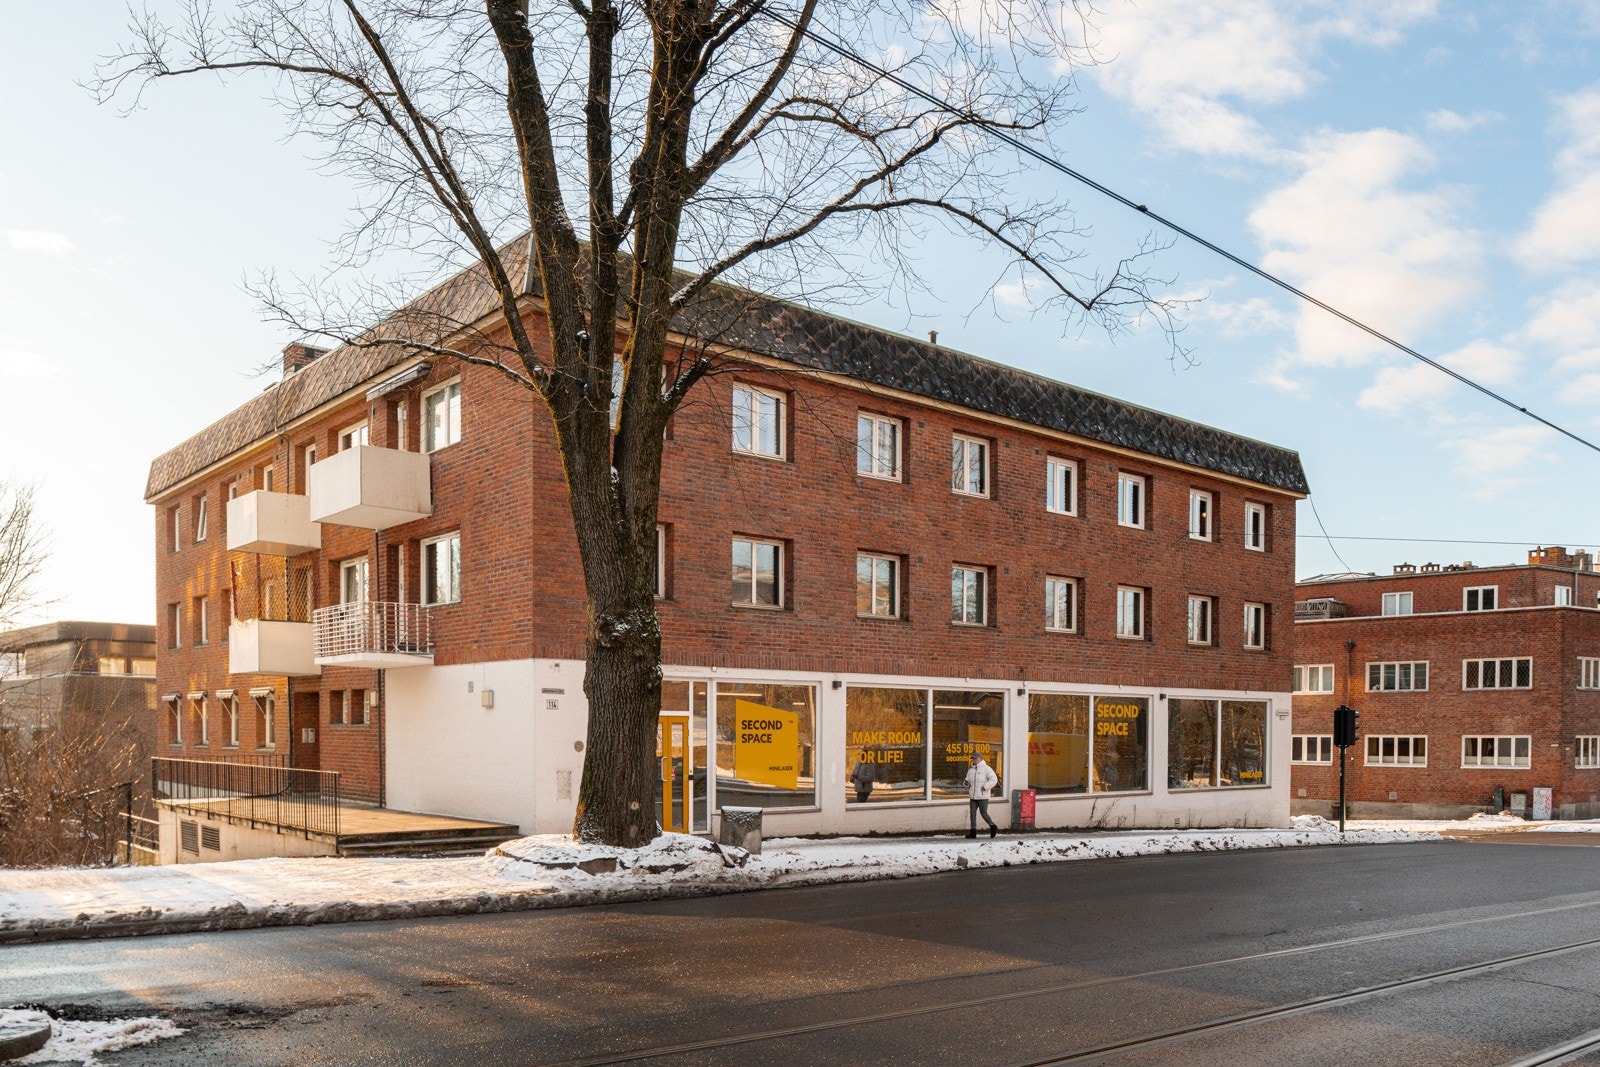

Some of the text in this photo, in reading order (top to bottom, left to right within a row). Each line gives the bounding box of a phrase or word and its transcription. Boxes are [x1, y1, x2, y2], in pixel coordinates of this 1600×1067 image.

[1097, 704, 1139, 718] SECOND
[741, 720, 783, 730] SECOND
[1097, 722, 1128, 736] SPACE
[741, 733, 772, 744] SPACE
[852, 731, 921, 744] MAKE ROOM
[946, 743, 991, 753] 455 05 800
[852, 750, 904, 763] FOR LIFE!
